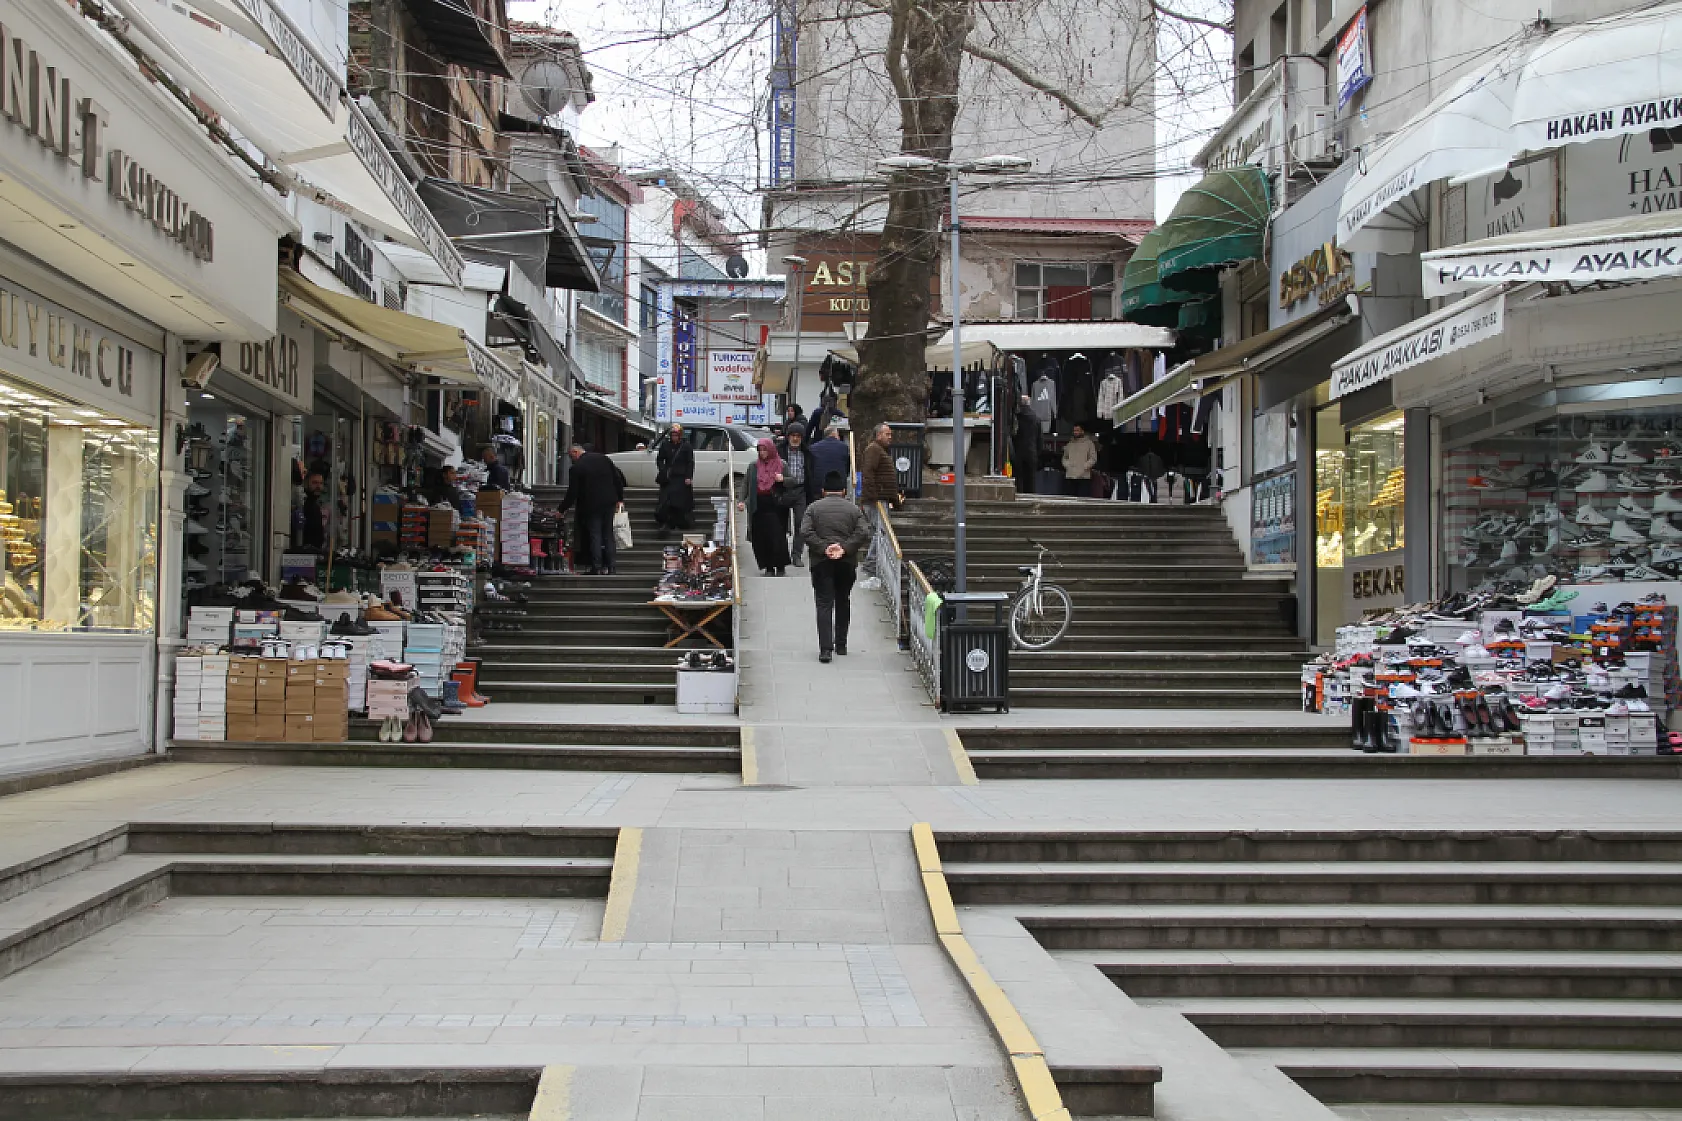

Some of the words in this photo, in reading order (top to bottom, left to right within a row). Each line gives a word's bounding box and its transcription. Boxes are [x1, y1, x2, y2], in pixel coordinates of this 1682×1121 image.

[1547, 110, 1613, 140] HAKAN
[1486, 203, 1525, 238] HAKAN
[1438, 257, 1551, 284] HAKAN
[1338, 355, 1380, 391] HAKAN
[1381, 326, 1446, 373] AYAKKABI
[1353, 565, 1404, 600] BEKAR
